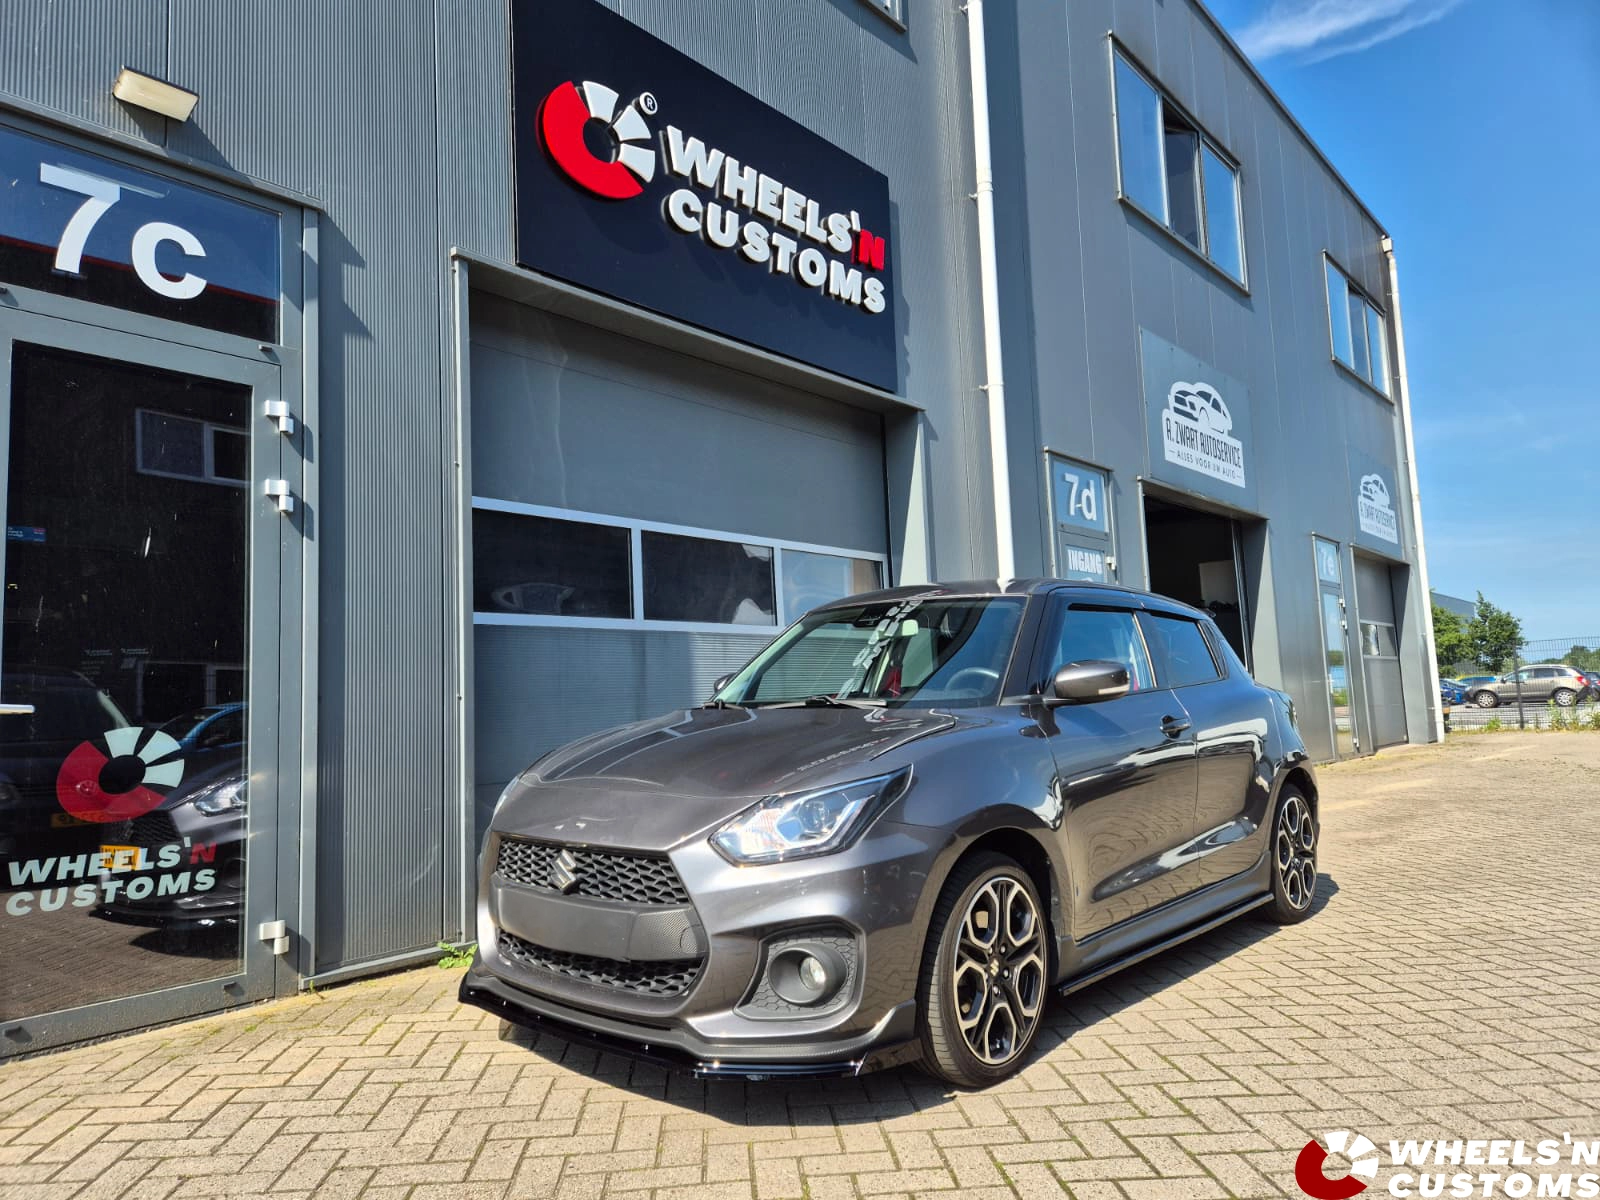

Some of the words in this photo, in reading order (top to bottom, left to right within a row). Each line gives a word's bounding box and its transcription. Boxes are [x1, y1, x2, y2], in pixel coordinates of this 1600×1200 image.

[665, 125, 885, 271] WHEELS'N
[665, 188, 885, 313] CUSTOMS
[1174, 420, 1199, 451] ZWART
[1199, 431, 1242, 469] AUTOSERVICE
[1067, 548, 1104, 575] INGANG
[8, 836, 218, 887] WHEELS'N
[5, 868, 217, 916] CUSTOMS
